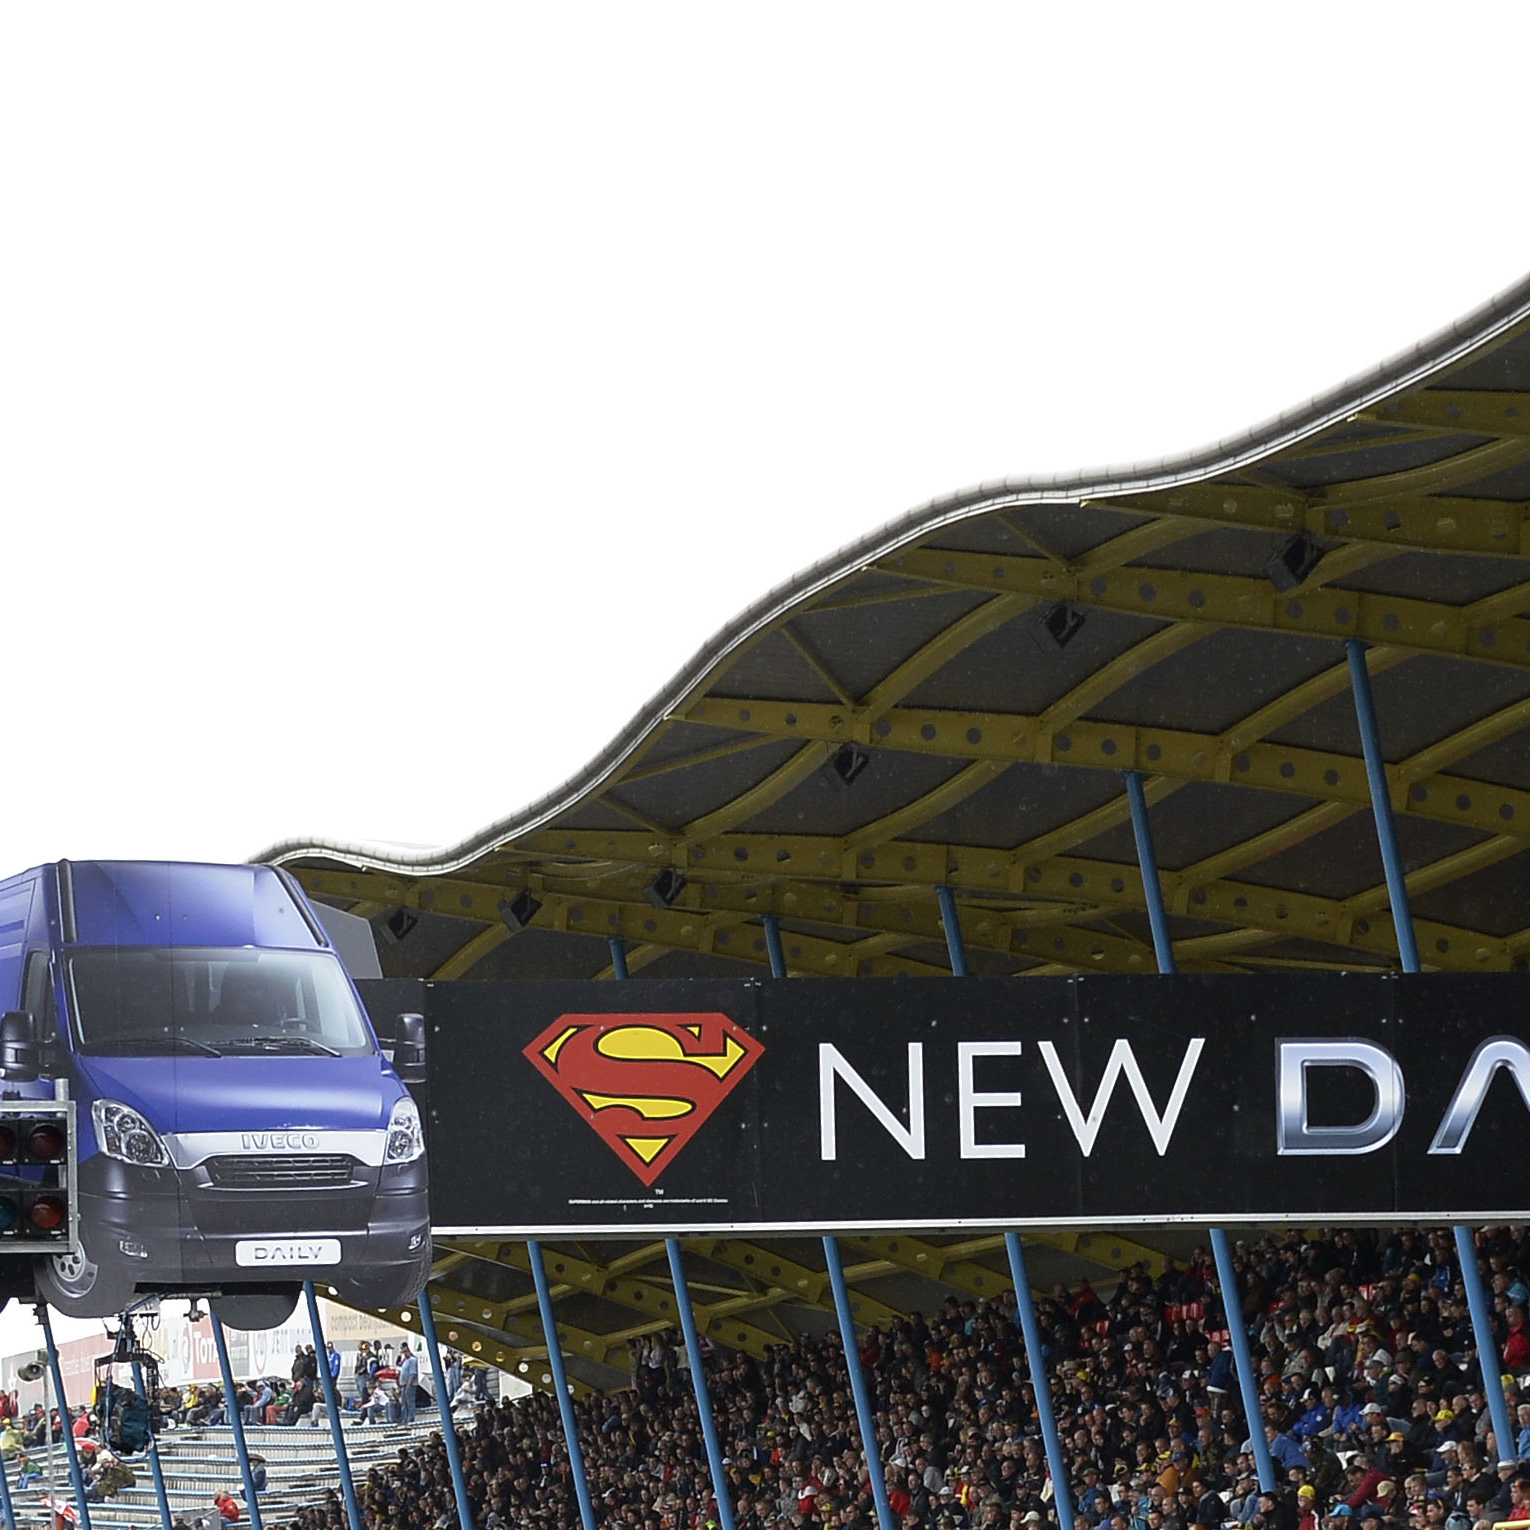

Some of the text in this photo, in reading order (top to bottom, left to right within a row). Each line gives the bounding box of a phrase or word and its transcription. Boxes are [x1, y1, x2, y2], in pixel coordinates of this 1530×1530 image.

[818, 1038, 1206, 1161] NEW
[240, 1133, 320, 1150] IVECO
[254, 1246, 322, 1260] DAILY
